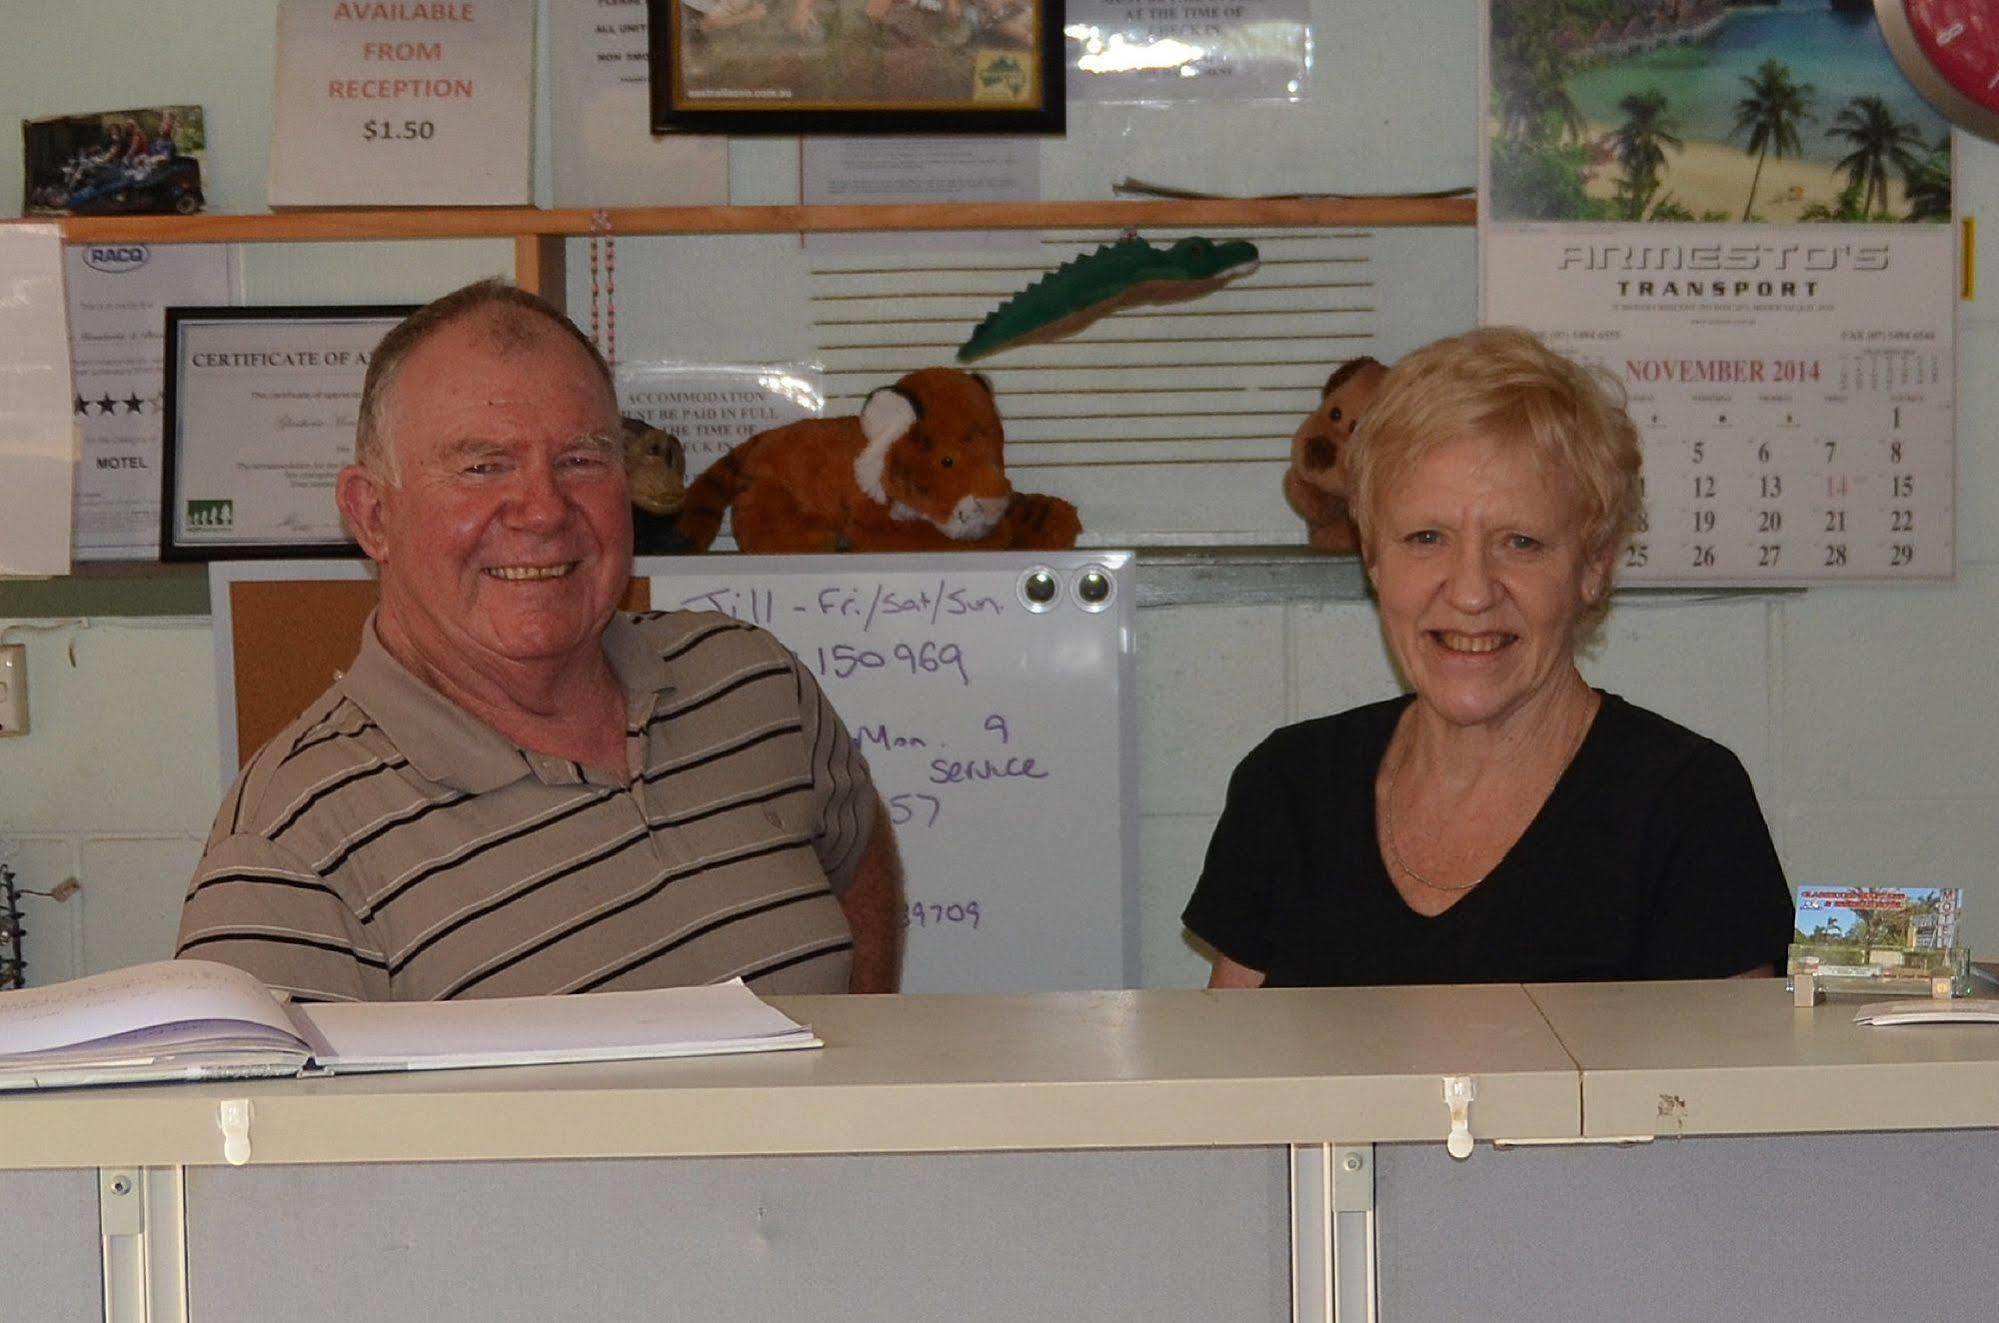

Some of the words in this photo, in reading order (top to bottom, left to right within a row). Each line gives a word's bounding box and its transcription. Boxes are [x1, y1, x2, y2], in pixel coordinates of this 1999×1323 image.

[334, 2, 475, 22] AVAILABLE
[1149, 8, 1177, 20] THE
[1184, 7, 1219, 19] TIME
[362, 42, 443, 61] FROM
[328, 79, 475, 99] RECEPTION
[363, 119, 435, 141] $1.50
[93, 248, 144, 262] RACQ
[1558, 245, 1889, 271] ARMESTO'S
[1617, 280, 1820, 298] TRANSPORT
[192, 352, 319, 367] CERTIFICATE
[325, 351, 349, 366] OF
[1626, 360, 1767, 383] NOVEMBER
[1772, 360, 1824, 383] 2014
[629, 391, 764, 404] ACCOMMODATION
[659, 409, 677, 421] BE
[682, 408, 717, 421] PAID
[721, 407, 738, 420] IN
[741, 407, 778, 420] FULL
[1891, 406, 1899, 429] 1
[696, 424, 730, 437] TIME
[96, 456, 148, 469] MOTEL
[1691, 442, 1704, 464] 5
[1758, 442, 1770, 463] 6
[1825, 441, 1836, 463] 7
[1890, 442, 1902, 463] 8
[1692, 477, 1715, 498] 12
[1760, 477, 1782, 498] 13
[1826, 477, 1848, 497] 14
[1892, 476, 1914, 498] 15
[1693, 511, 1716, 532] 19
[1758, 511, 1781, 532] 20
[1825, 511, 1847, 532] 21
[1890, 511, 1914, 532] 22
[1625, 545, 1648, 567] 25
[1692, 545, 1715, 567] 26
[1758, 545, 1781, 567] 27
[1825, 545, 1847, 567] 28
[1890, 544, 1914, 567] 29
[984, 715, 1008, 744] 9
